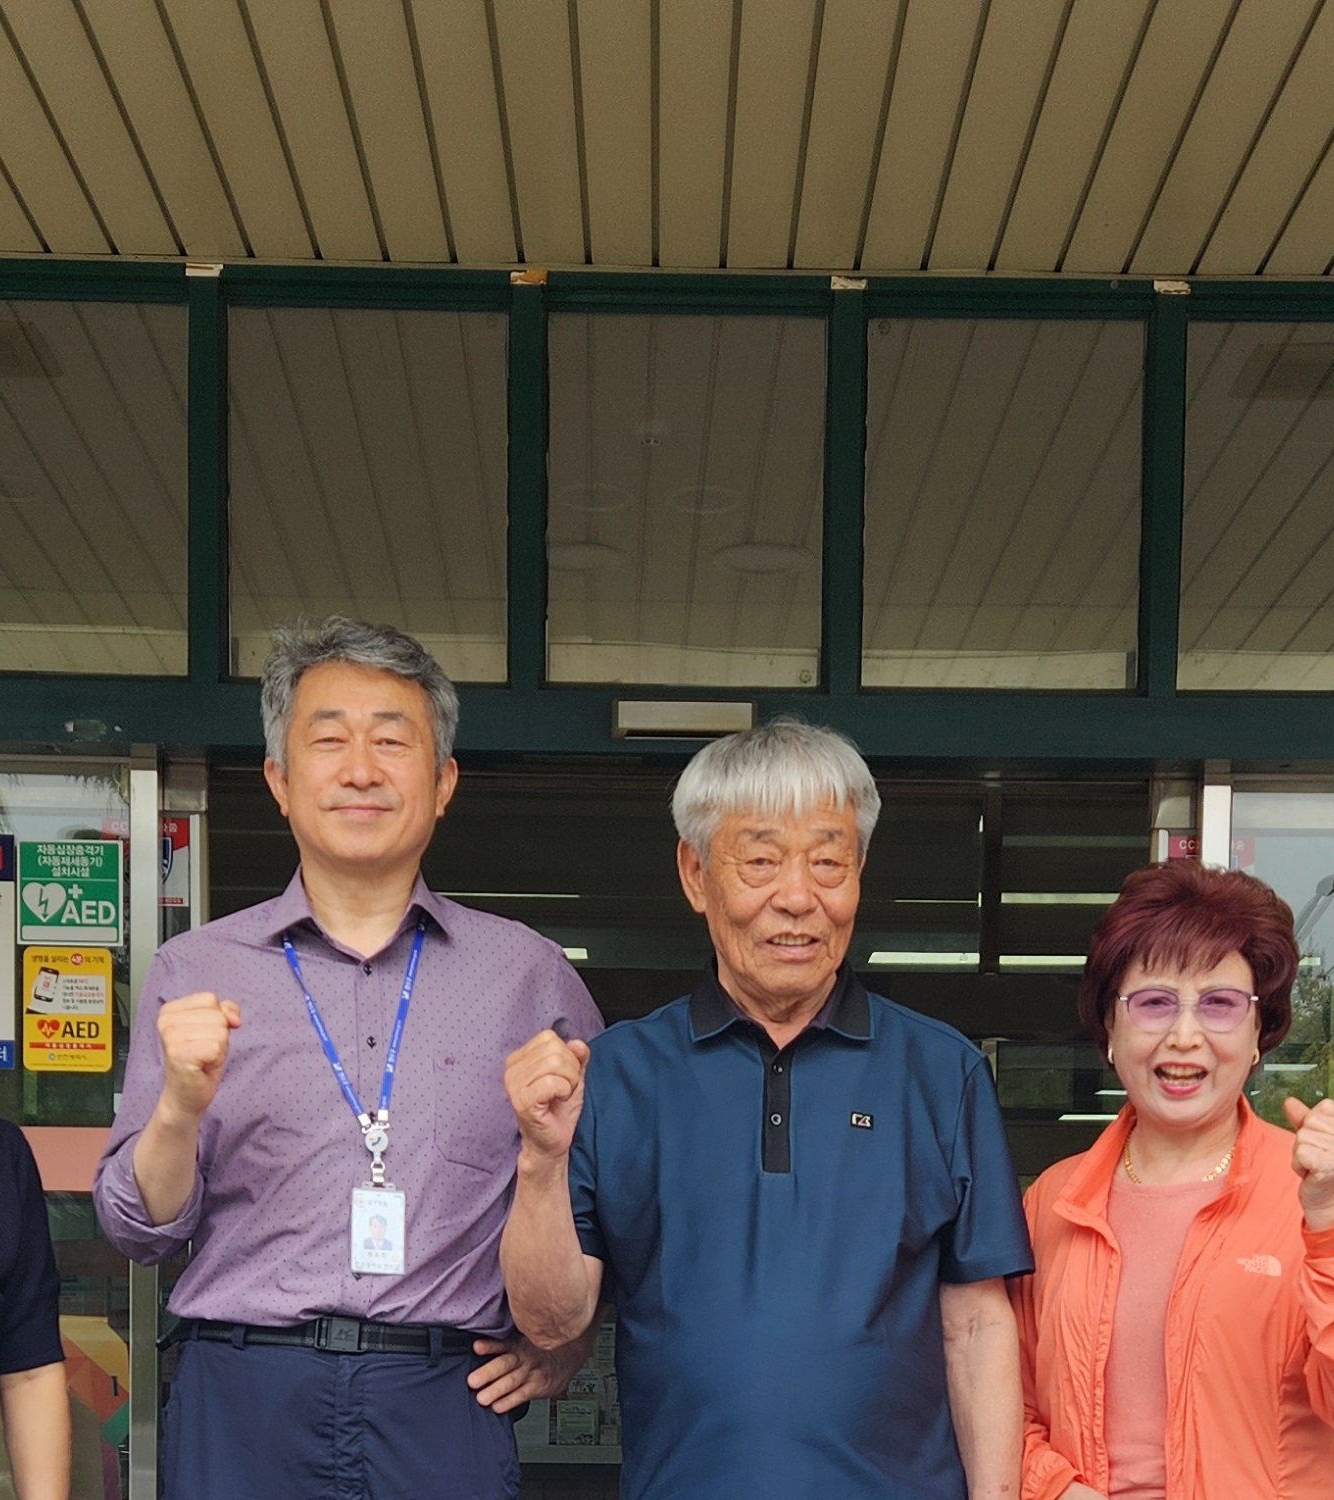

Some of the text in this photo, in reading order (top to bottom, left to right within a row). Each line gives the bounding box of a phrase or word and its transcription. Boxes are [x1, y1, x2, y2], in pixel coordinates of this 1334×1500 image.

[36, 844, 104, 856] 자동심장충격기
[37, 856, 103, 867] (자동제세동기)
[51, 866, 90, 877] 설치시설
[60, 900, 116, 924] AED
[61, 1020, 100, 1039] AED
